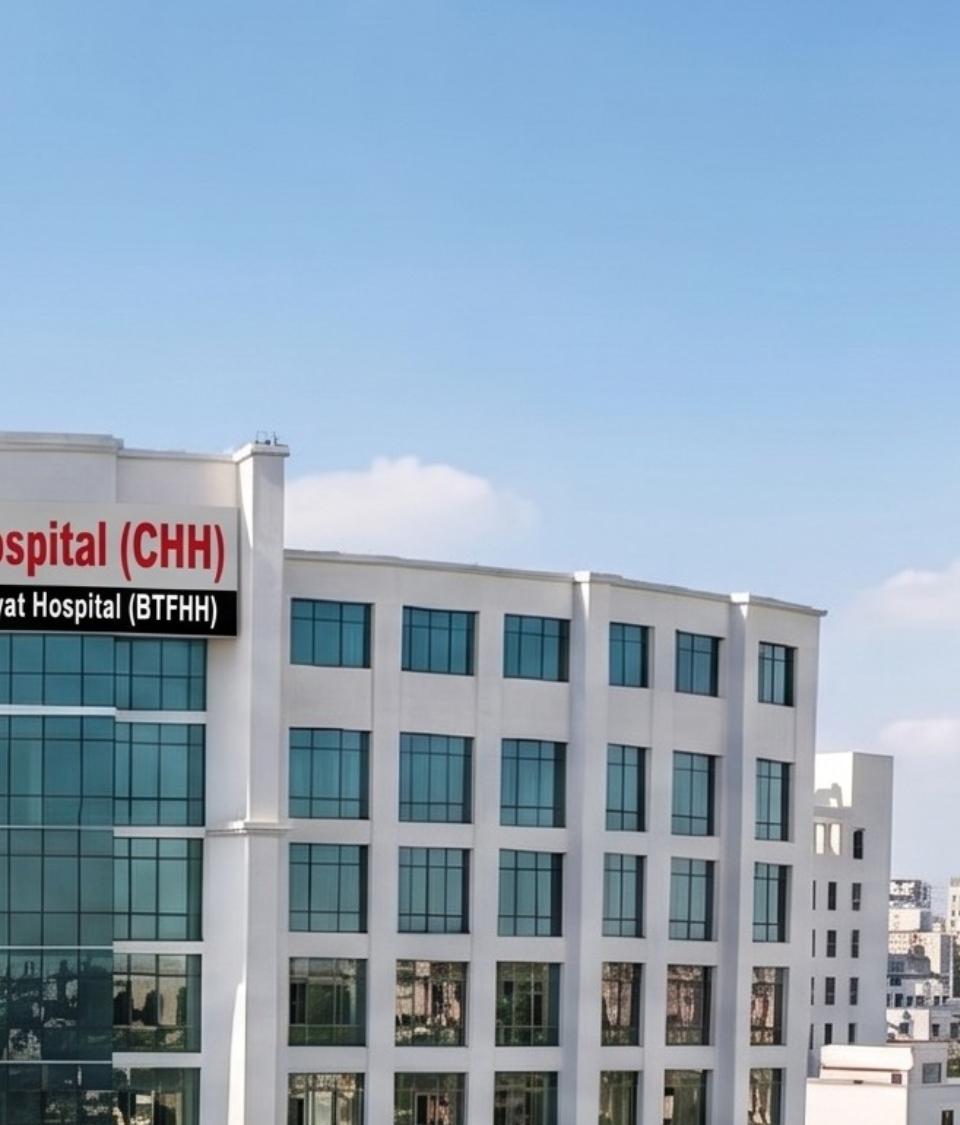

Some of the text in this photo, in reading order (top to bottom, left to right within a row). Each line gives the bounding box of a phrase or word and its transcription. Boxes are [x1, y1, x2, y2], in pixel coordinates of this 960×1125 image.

[120, 521, 224, 583] (CHH)
[33, 592, 120, 624] Hospital
[129, 593, 217, 628] (BTFHH)
